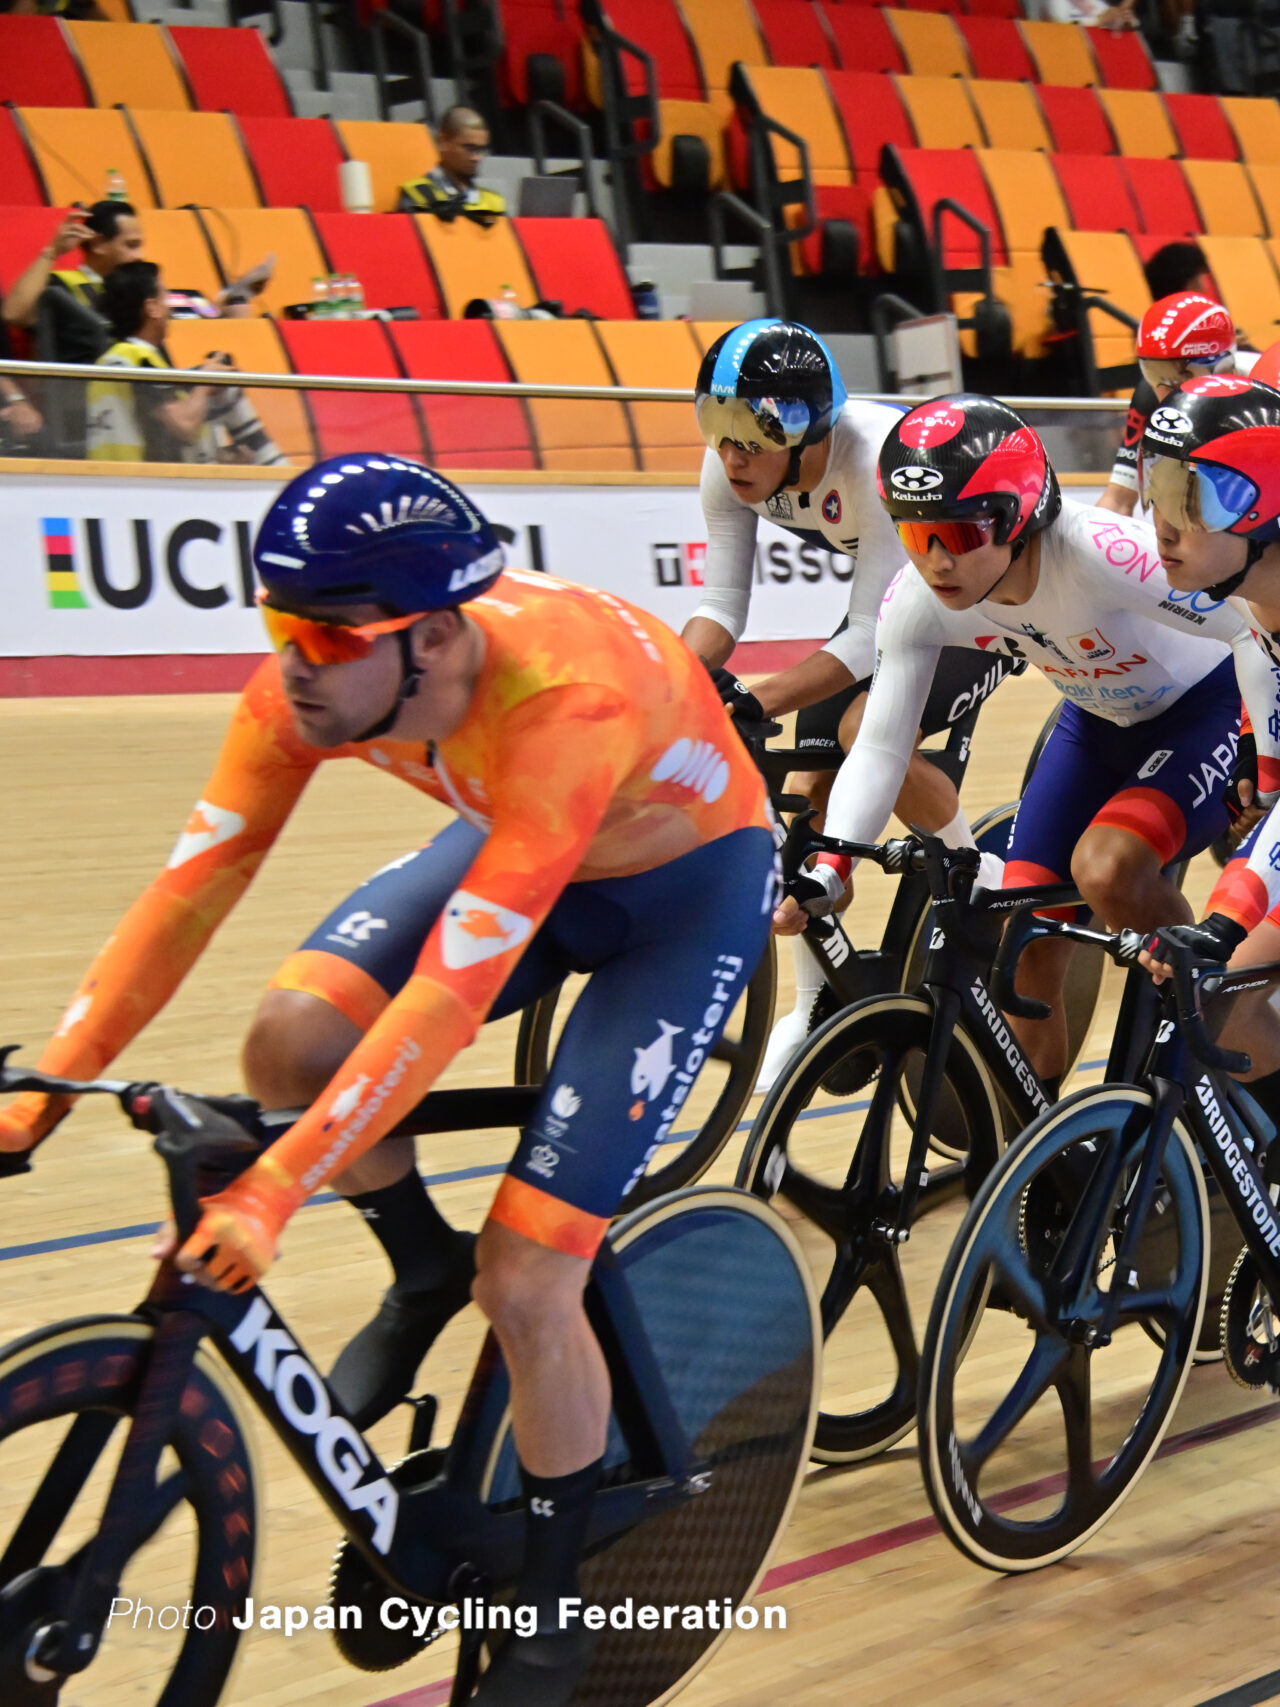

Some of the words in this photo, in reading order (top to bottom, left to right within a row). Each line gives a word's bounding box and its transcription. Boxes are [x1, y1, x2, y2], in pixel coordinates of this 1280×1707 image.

[1181, 342, 1219, 356] GIRO
[711, 384, 735, 395] KASK
[1144, 427, 1184, 448] Kabuto
[892, 491, 943, 501] Kabuto
[84, 518, 258, 610] UCI
[1158, 600, 1207, 626] KEIRIN
[1044, 652, 1148, 679] APAN
[1188, 719, 1241, 809] JAPA
[970, 976, 1050, 1116] BRIDGEST
[621, 954, 744, 1197] atsloterij
[229, 1296, 400, 1556] KOGA
